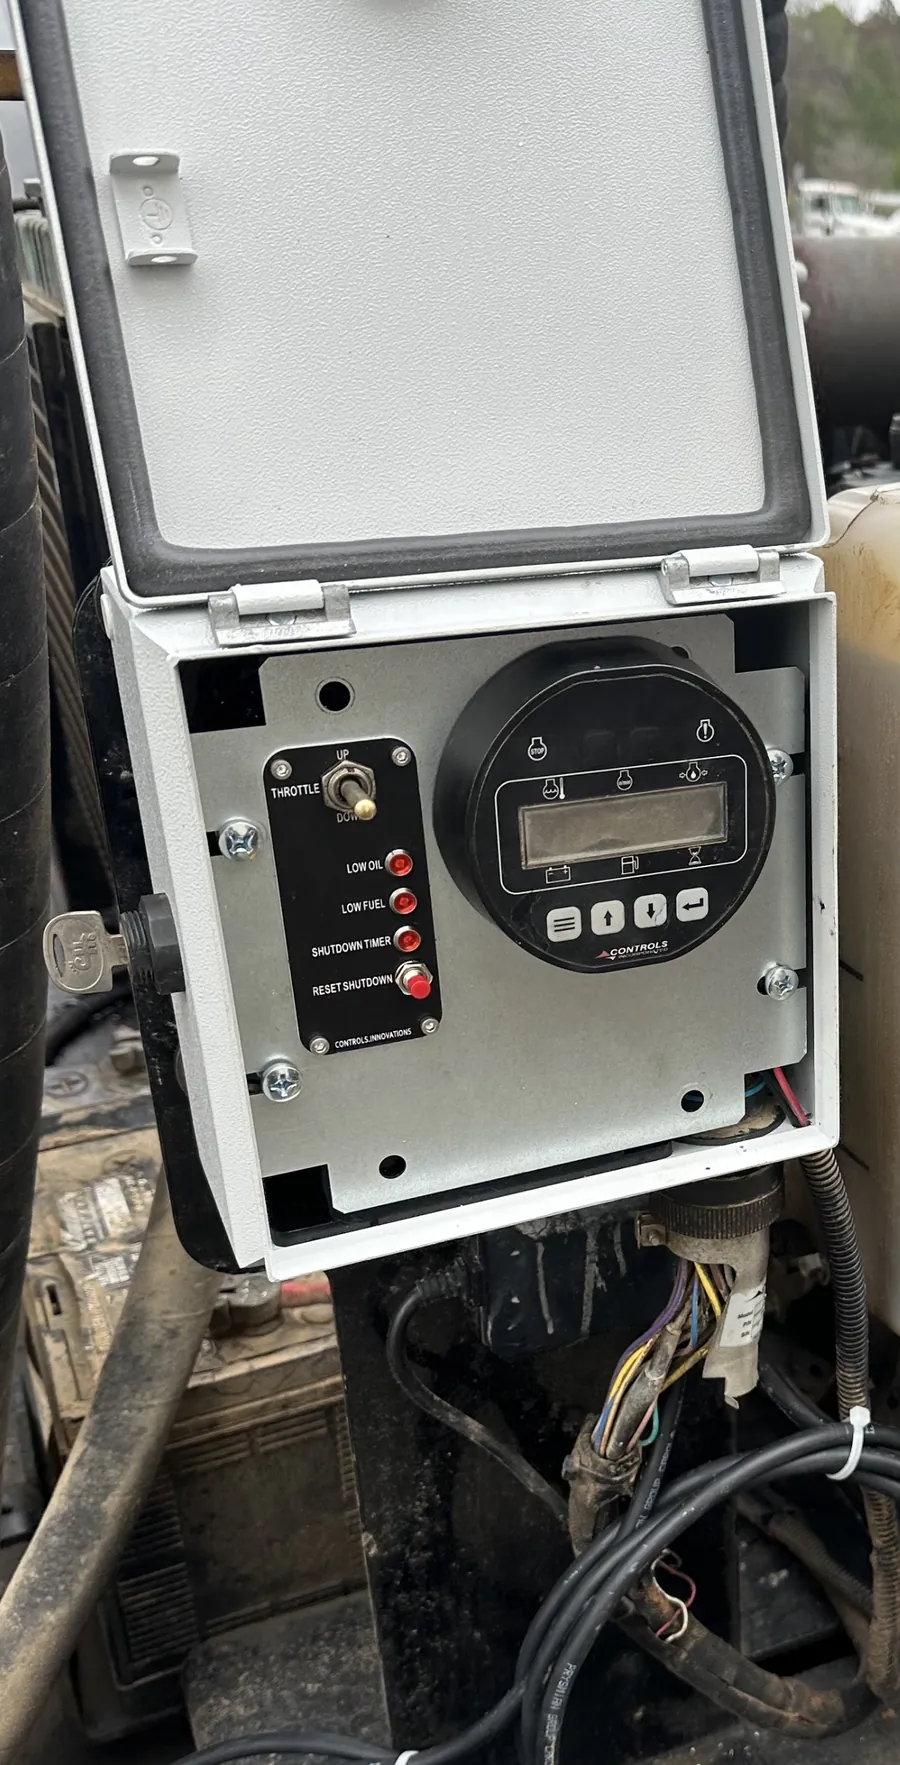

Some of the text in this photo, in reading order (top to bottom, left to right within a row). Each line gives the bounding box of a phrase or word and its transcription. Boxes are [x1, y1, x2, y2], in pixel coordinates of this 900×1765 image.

[336, 749, 350, 761] UP
[531, 747, 545, 756] STOP
[271, 783, 320, 799] THROTTLE
[336, 811, 360, 823] DOW
[346, 860, 383, 874] LOW OIL
[341, 899, 386, 914] LOW FUEL
[311, 935, 392, 957] SHUTDOWN TIMER
[610, 940, 669, 956] CONTROLS
[312, 974, 393, 997] RESET SHUTDOWN
[550, 1662, 577, 1710] PRYSMIAN
